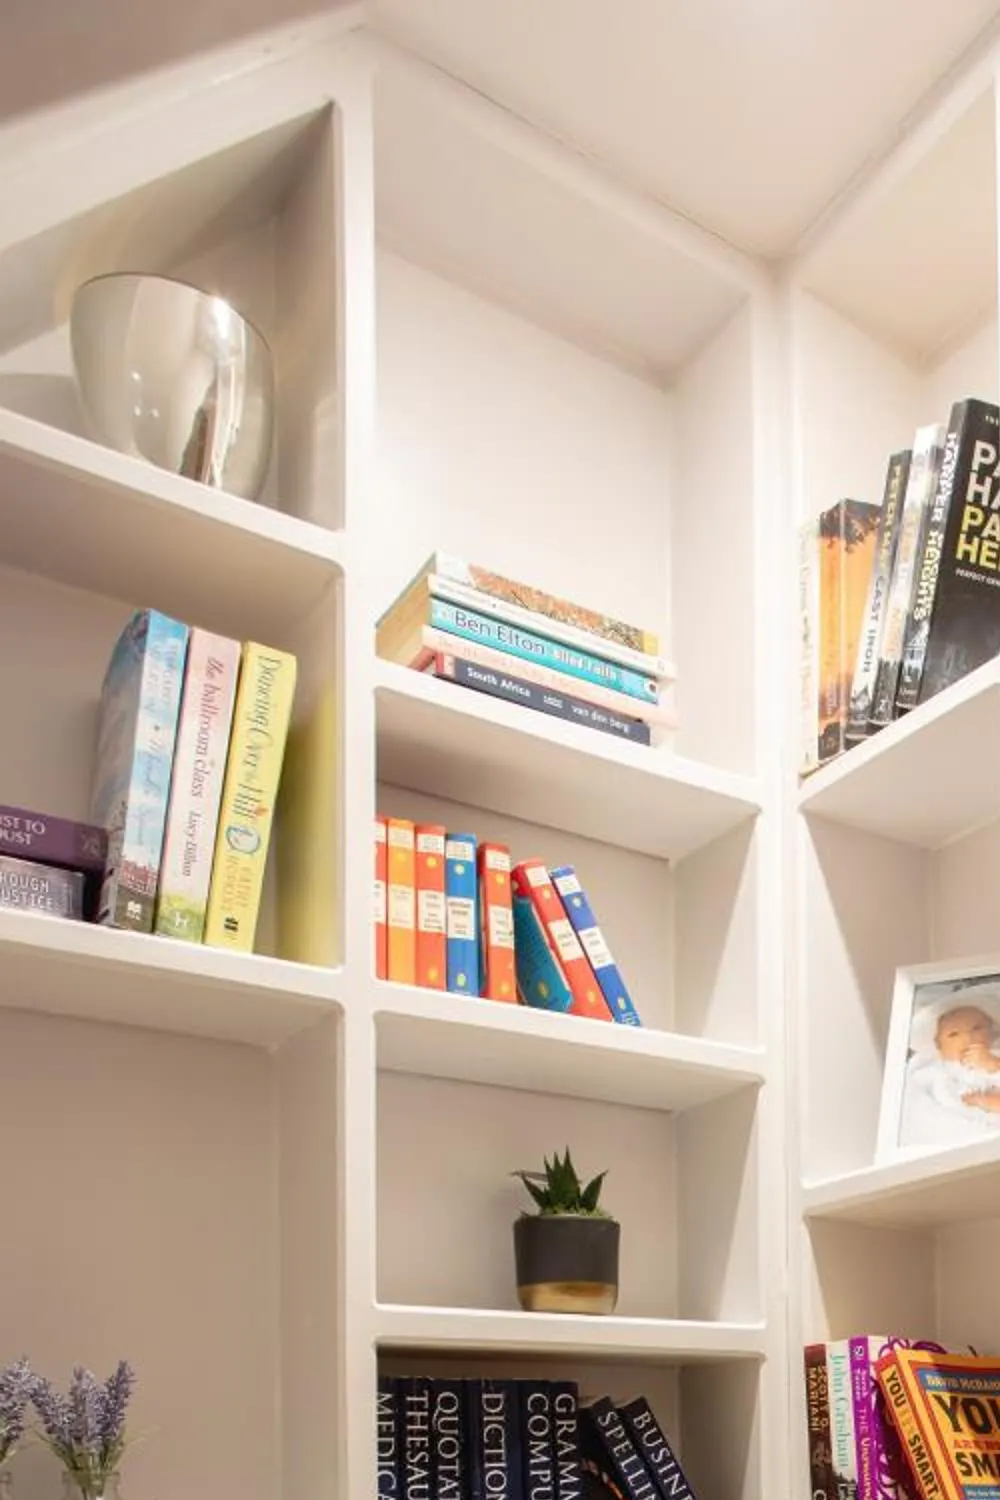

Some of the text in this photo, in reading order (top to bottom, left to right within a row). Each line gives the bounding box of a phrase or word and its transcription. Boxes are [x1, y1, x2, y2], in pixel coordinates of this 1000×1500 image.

[930, 432, 957, 522] HARPER
[913, 529, 938, 622] HEIGHTS
[455, 610, 491, 637] Ben
[497, 625, 545, 655] Elton
[862, 575, 884, 674] CAST IRON
[246, 655, 281, 728] Dancing
[466, 667, 498, 688] South
[500, 677, 531, 699] Africa
[182, 656, 225, 878] the ballroom class Lucy Dillon
[0, 829, 32, 846] UST
[24, 819, 46, 835] TO
[0, 886, 53, 911] USTICE
[809, 1367, 821, 1432] MARIANI
[831, 1354, 852, 1467] John Grisham
[858, 1407, 869, 1433] THE
[885, 1371, 939, 1495] YOU SMART
